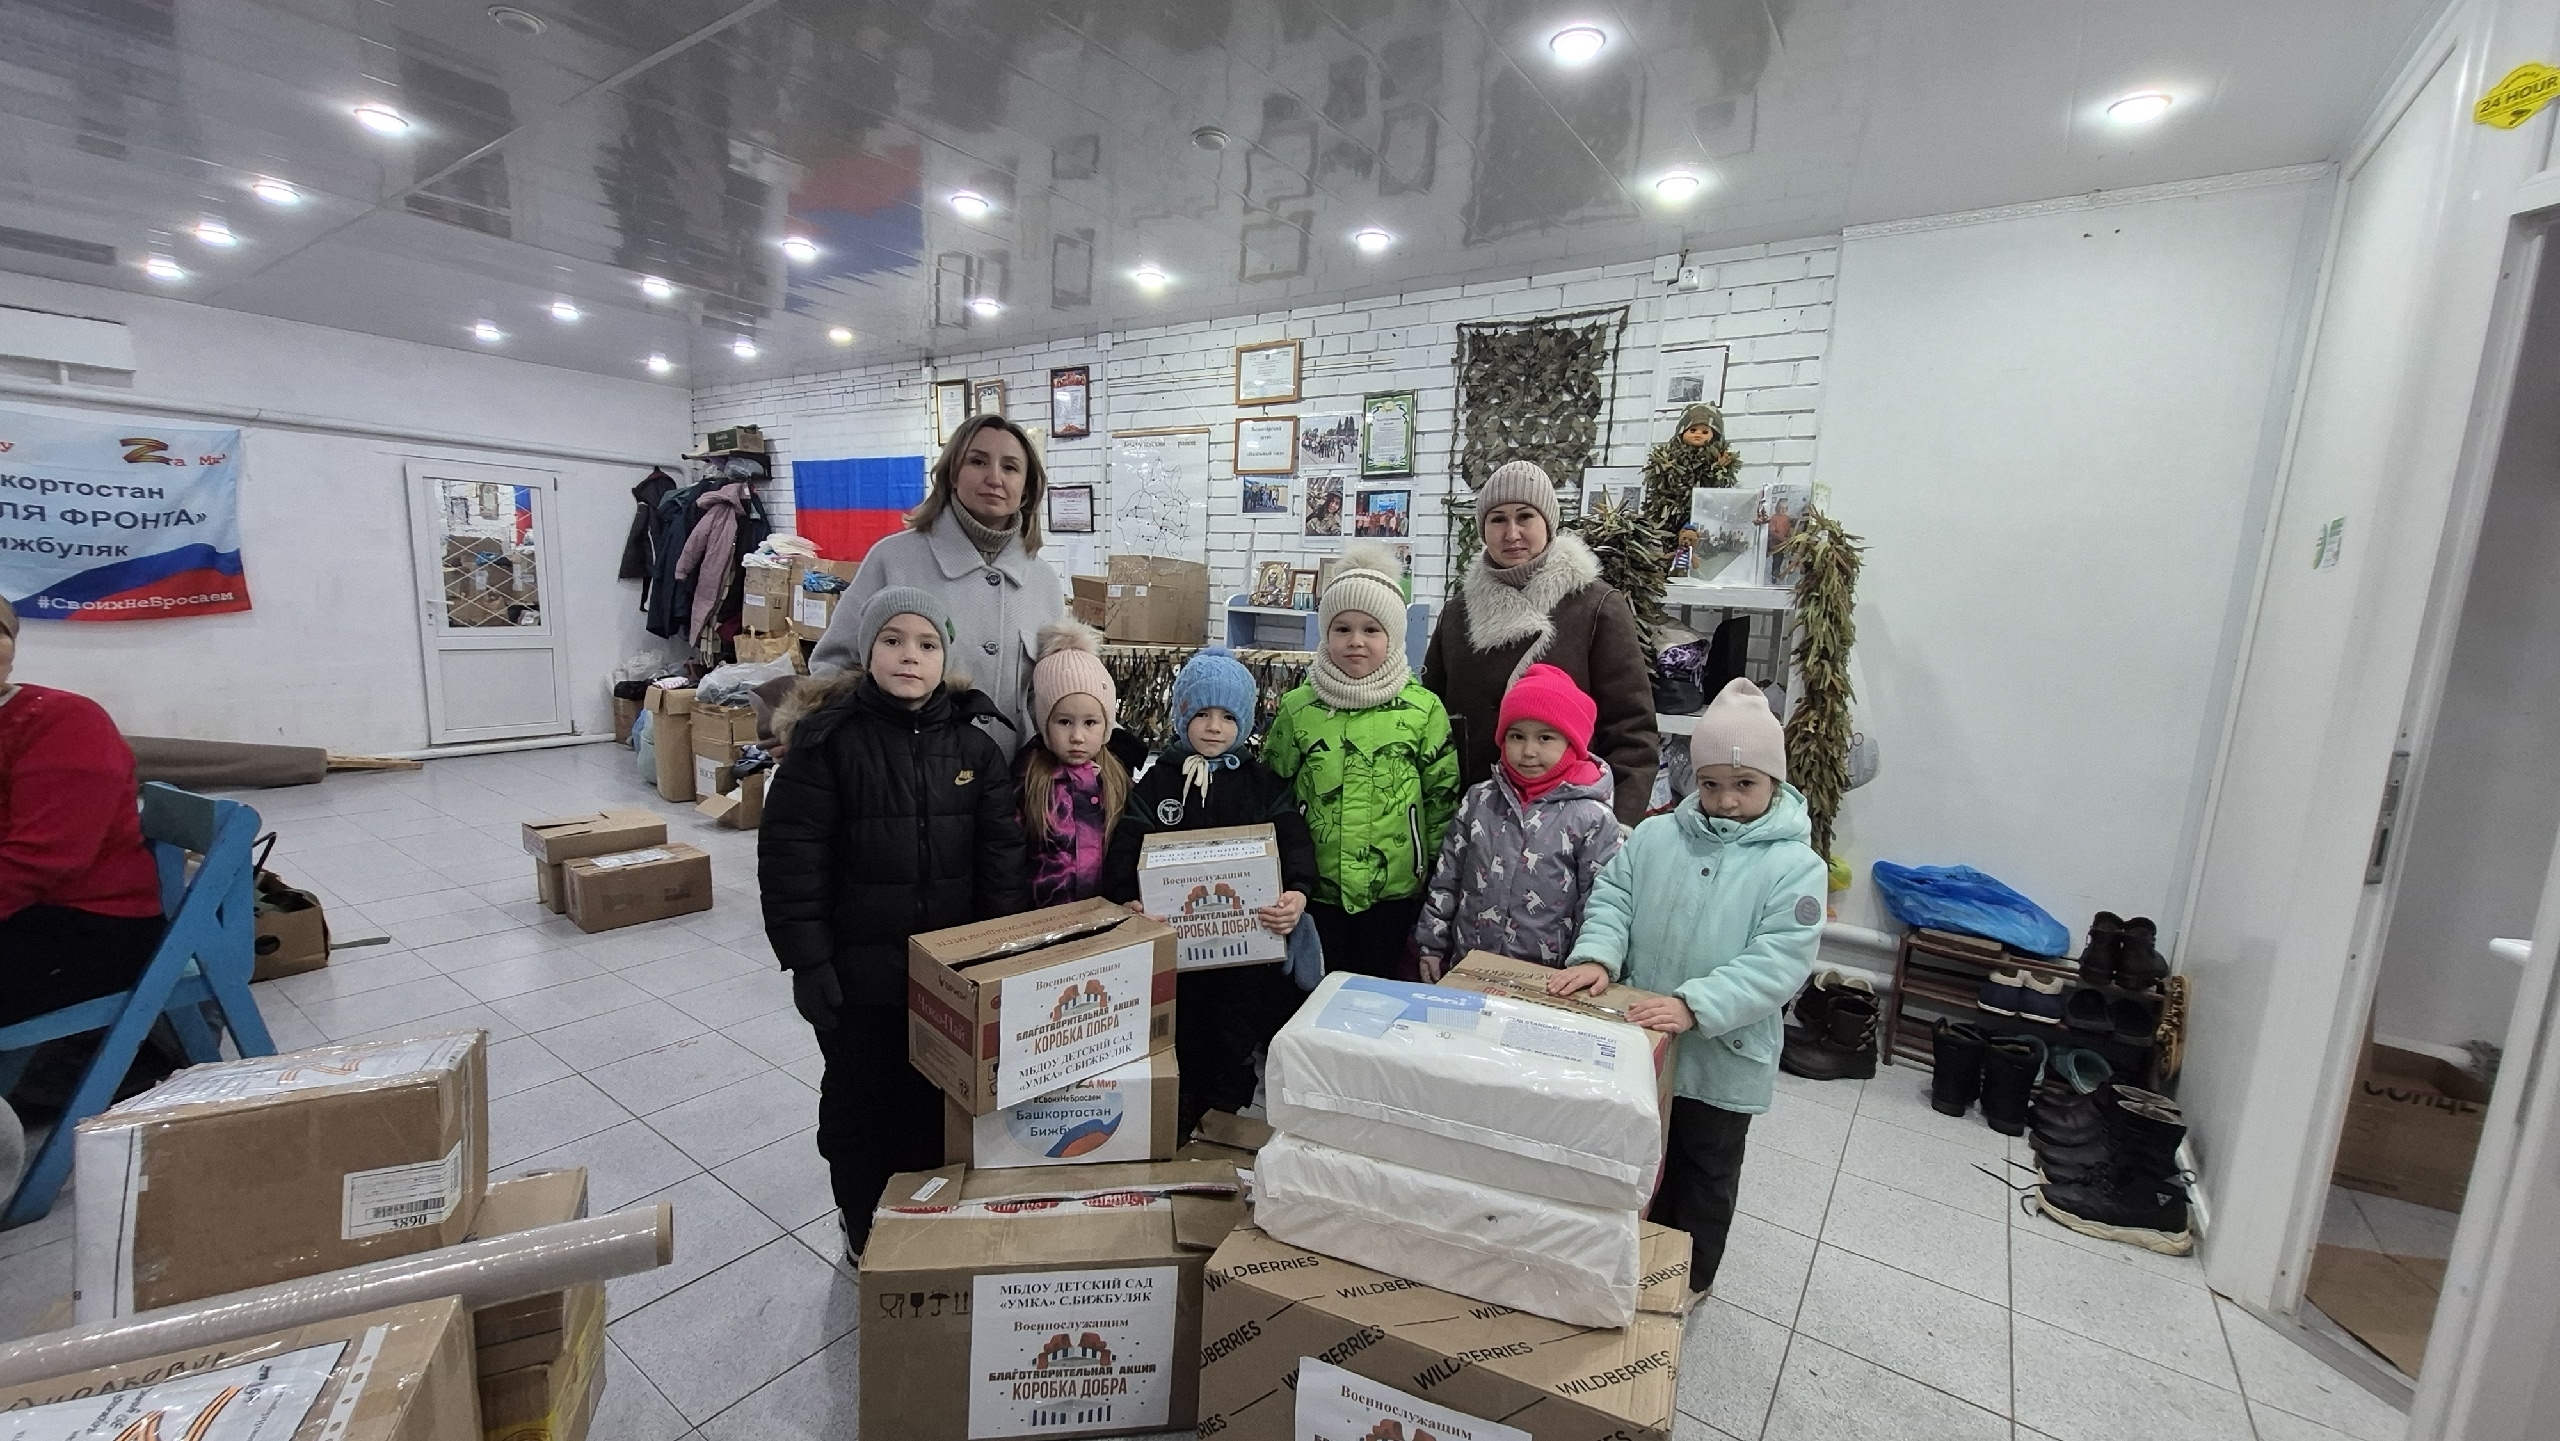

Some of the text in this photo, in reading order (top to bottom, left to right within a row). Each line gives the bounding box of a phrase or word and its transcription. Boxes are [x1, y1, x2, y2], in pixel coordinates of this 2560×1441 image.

[2479, 96, 2501, 113] 24
[2505, 75, 2558, 104] HOUR
[37, 590, 235, 610] #СвоихНеБросаем
[1175, 917, 1258, 940] ОРОБКА ДОБРА
[1034, 1014, 1119, 1055] КОРОБКА ДОБРА
[1019, 1031, 1133, 1080] МБДОУ ДЕТСКИЙ САД
[1096, 1080, 1117, 1091] Мир
[1016, 1107, 1112, 1120] Башкортостан
[1204, 1256, 1320, 1292] WILDBERRIES
[1000, 1277, 1154, 1295] МБДОУ ДЕТСКИЙ САД
[1000, 1291, 1152, 1310] «УМКА» С.БИЖБУЛЯК
[1012, 1377, 1128, 1401] КОРОБКА ДОБРА
